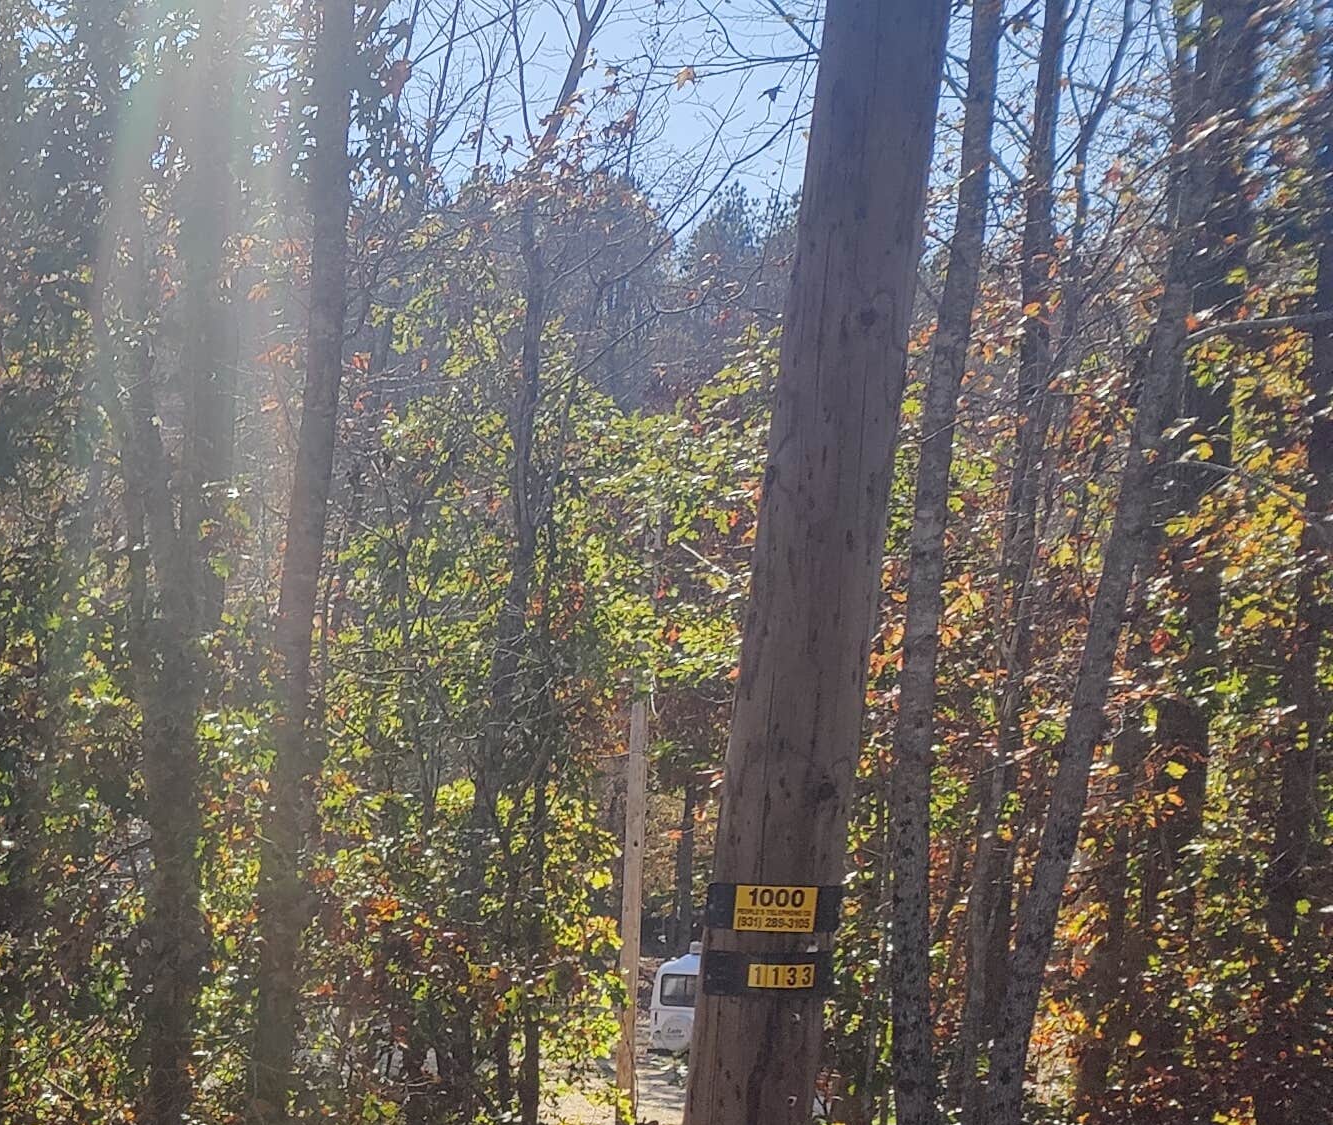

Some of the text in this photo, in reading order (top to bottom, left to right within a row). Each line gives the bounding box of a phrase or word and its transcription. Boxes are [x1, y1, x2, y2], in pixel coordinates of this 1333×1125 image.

[748, 888, 806, 908] 1000
[737, 916, 762, 928] (931)
[754, 966, 812, 986] 1133
